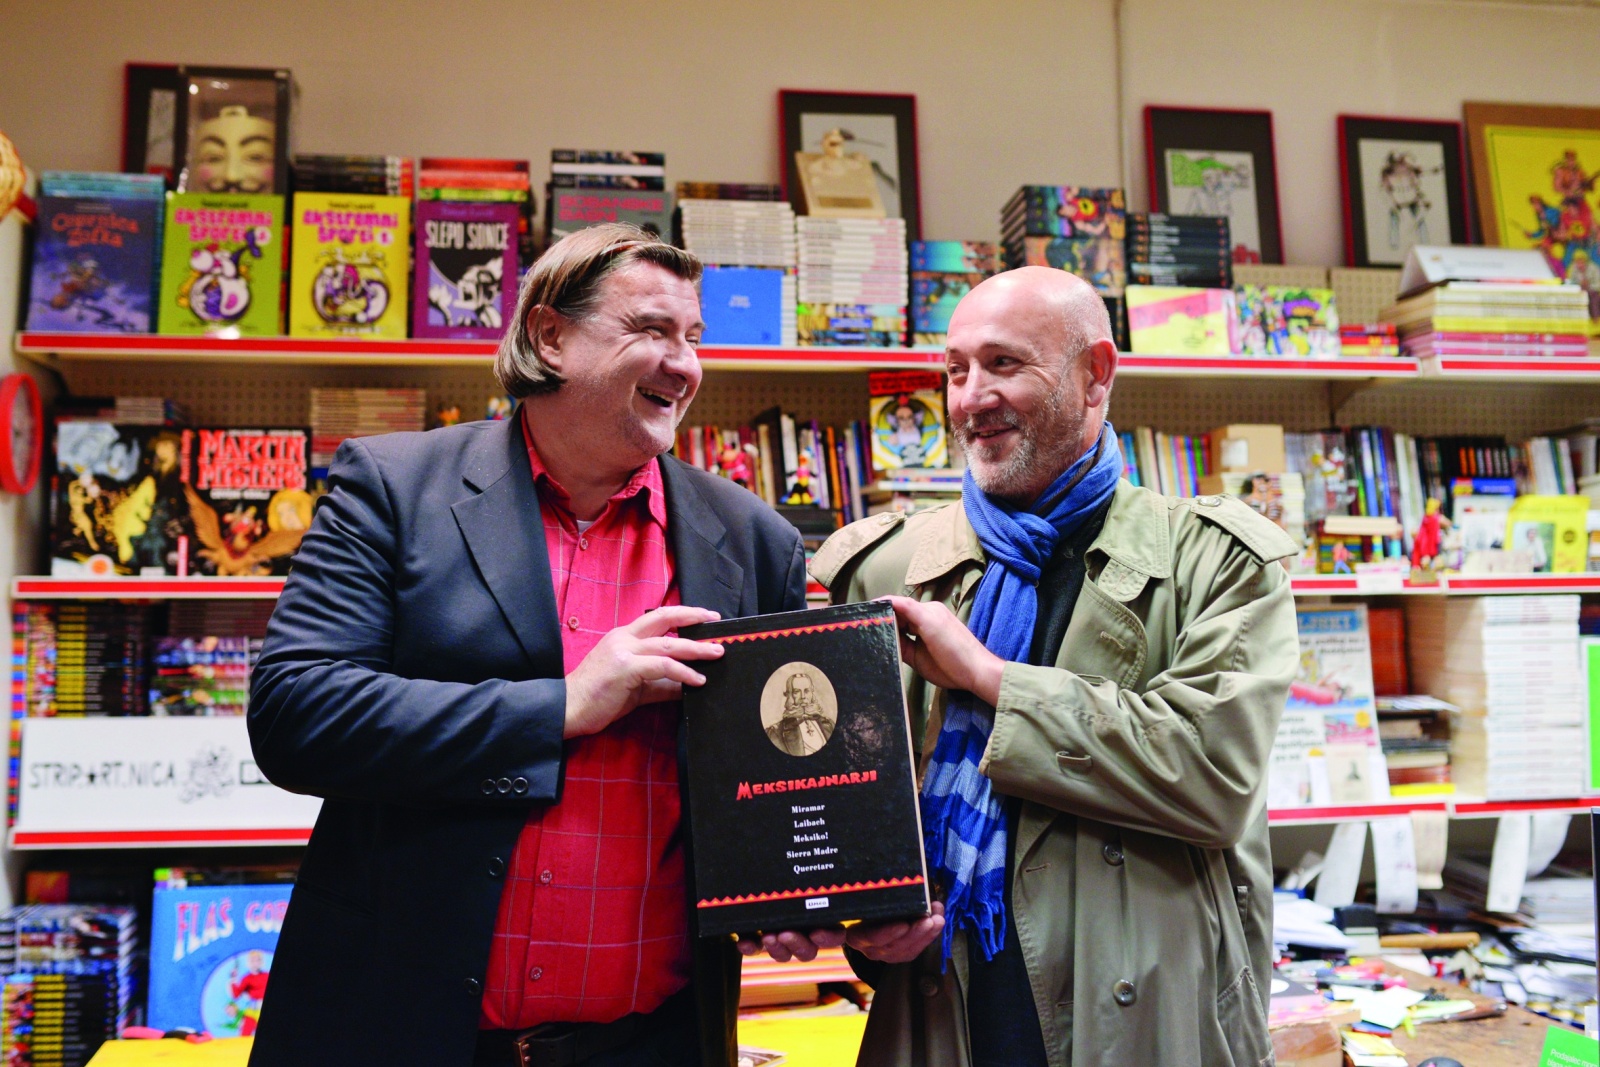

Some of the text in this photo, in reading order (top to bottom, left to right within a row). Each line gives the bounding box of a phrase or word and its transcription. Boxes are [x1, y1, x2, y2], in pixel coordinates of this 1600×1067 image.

[425, 221, 509, 250] SLEPO SONCE
[199, 430, 306, 461] MARTIN
[791, 804, 825, 814] Miramar
[794, 818, 825, 829] Laibach
[793, 832, 829, 844] Meksiko!
[786, 846, 838, 859] Sierra Madre
[793, 862, 834, 875] Queretaro
